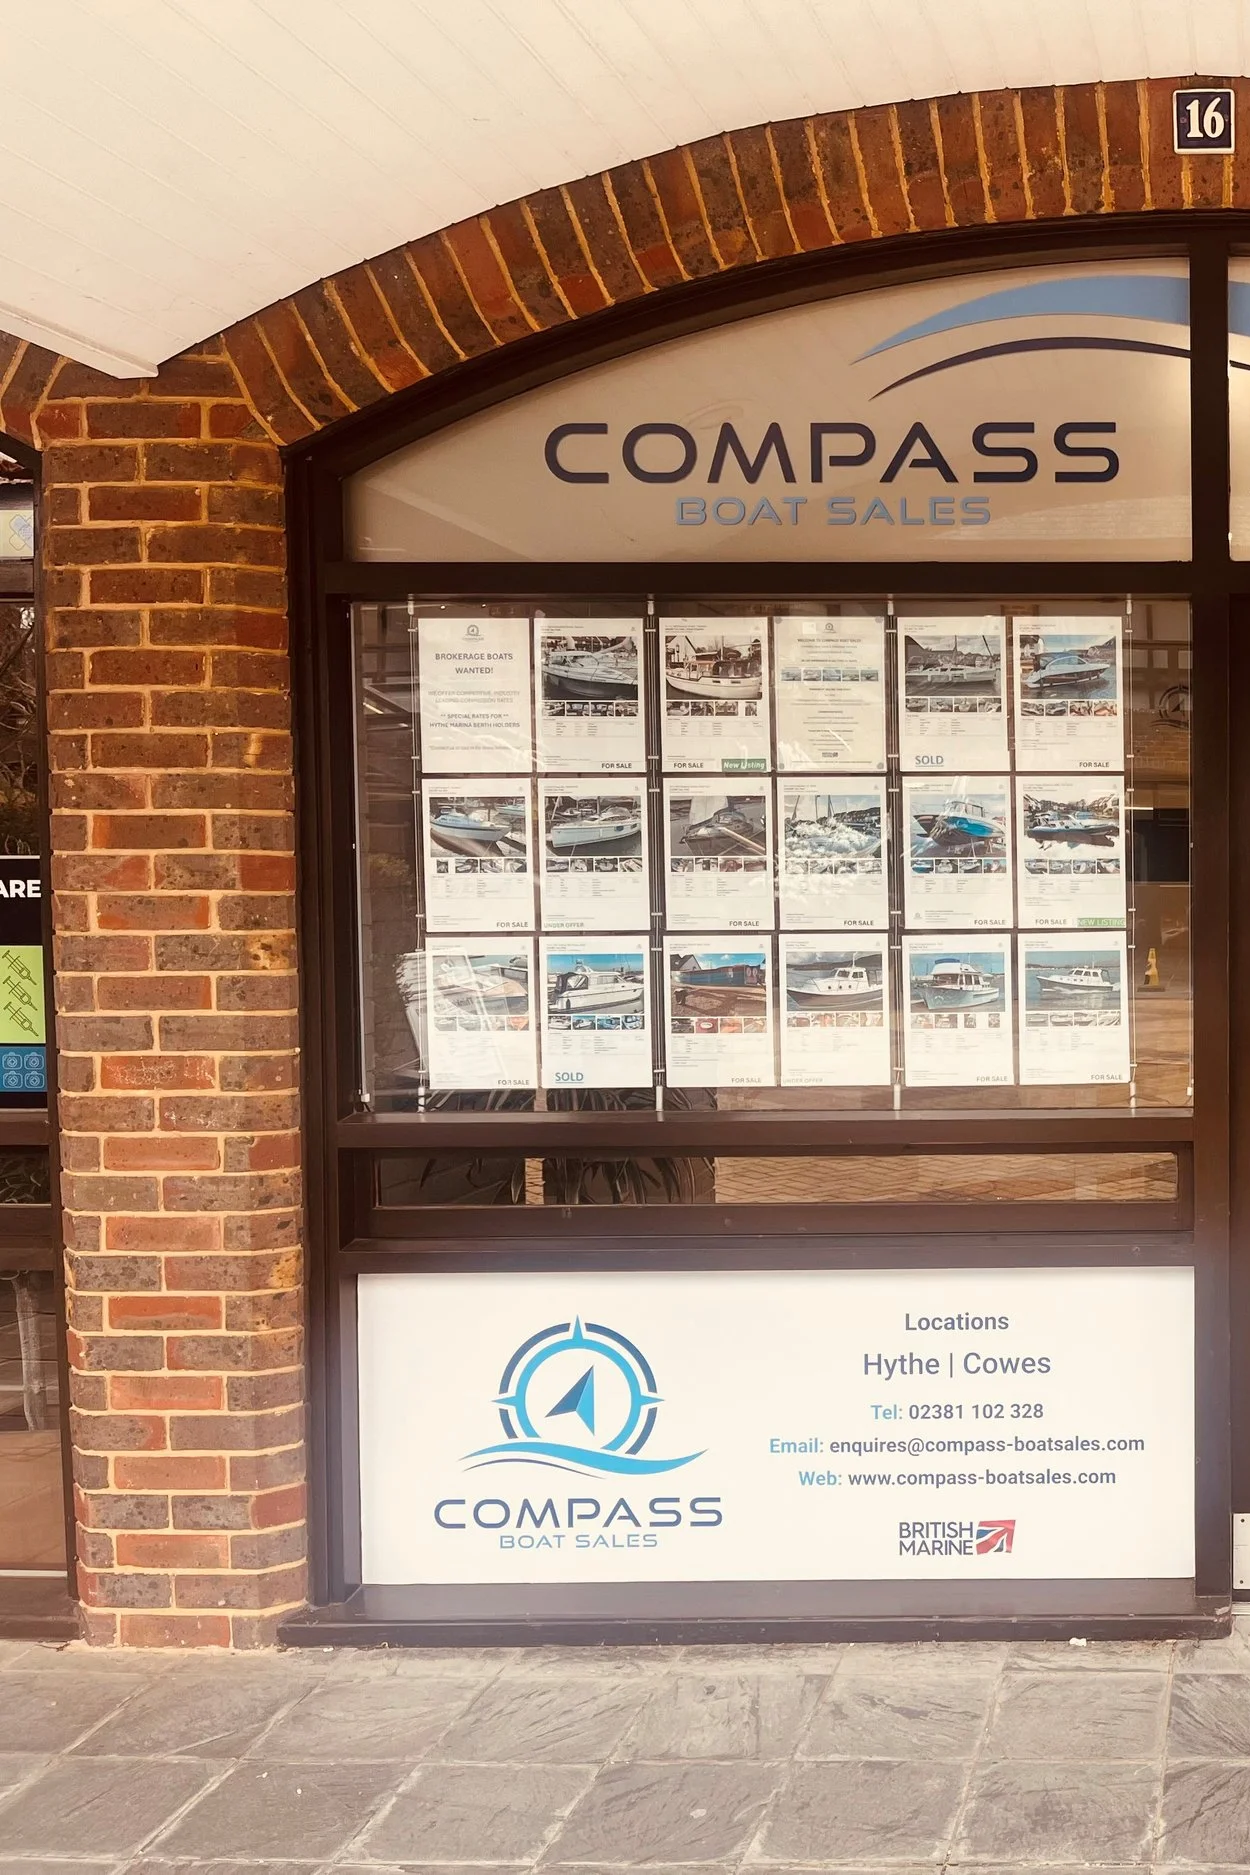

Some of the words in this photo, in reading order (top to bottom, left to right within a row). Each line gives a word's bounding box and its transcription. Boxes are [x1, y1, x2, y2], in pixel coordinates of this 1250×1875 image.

[1186, 96, 1225, 138] 16
[544, 421, 1120, 484] COMPASS
[675, 496, 808, 526] BOAT
[826, 496, 991, 526] SALES
[434, 653, 485, 661] BROKERAGE
[487, 653, 513, 661] BOATS
[915, 755, 944, 765] SOLD
[555, 1072, 584, 1082] SOLD
[905, 1313, 1009, 1332] Locations
[863, 1353, 940, 1381] Hythe
[963, 1352, 1052, 1375] Cowes
[871, 1405, 903, 1420] Tel:
[908, 1404, 964, 1420] 02381
[972, 1404, 1005, 1420] 102
[1010, 1404, 1044, 1419] 328
[769, 1437, 825, 1454] Email:
[829, 1436, 1145, 1457] enquires@compass-boatsales.com
[799, 1470, 843, 1487] Web:
[848, 1469, 1116, 1489] www.compass-boatsales.com
[434, 1497, 723, 1529] COMPASS
[899, 1521, 974, 1539] BRITISH
[500, 1535, 565, 1549] BOAT
[575, 1534, 658, 1549] SALES
[899, 1540, 974, 1556] MARINE
